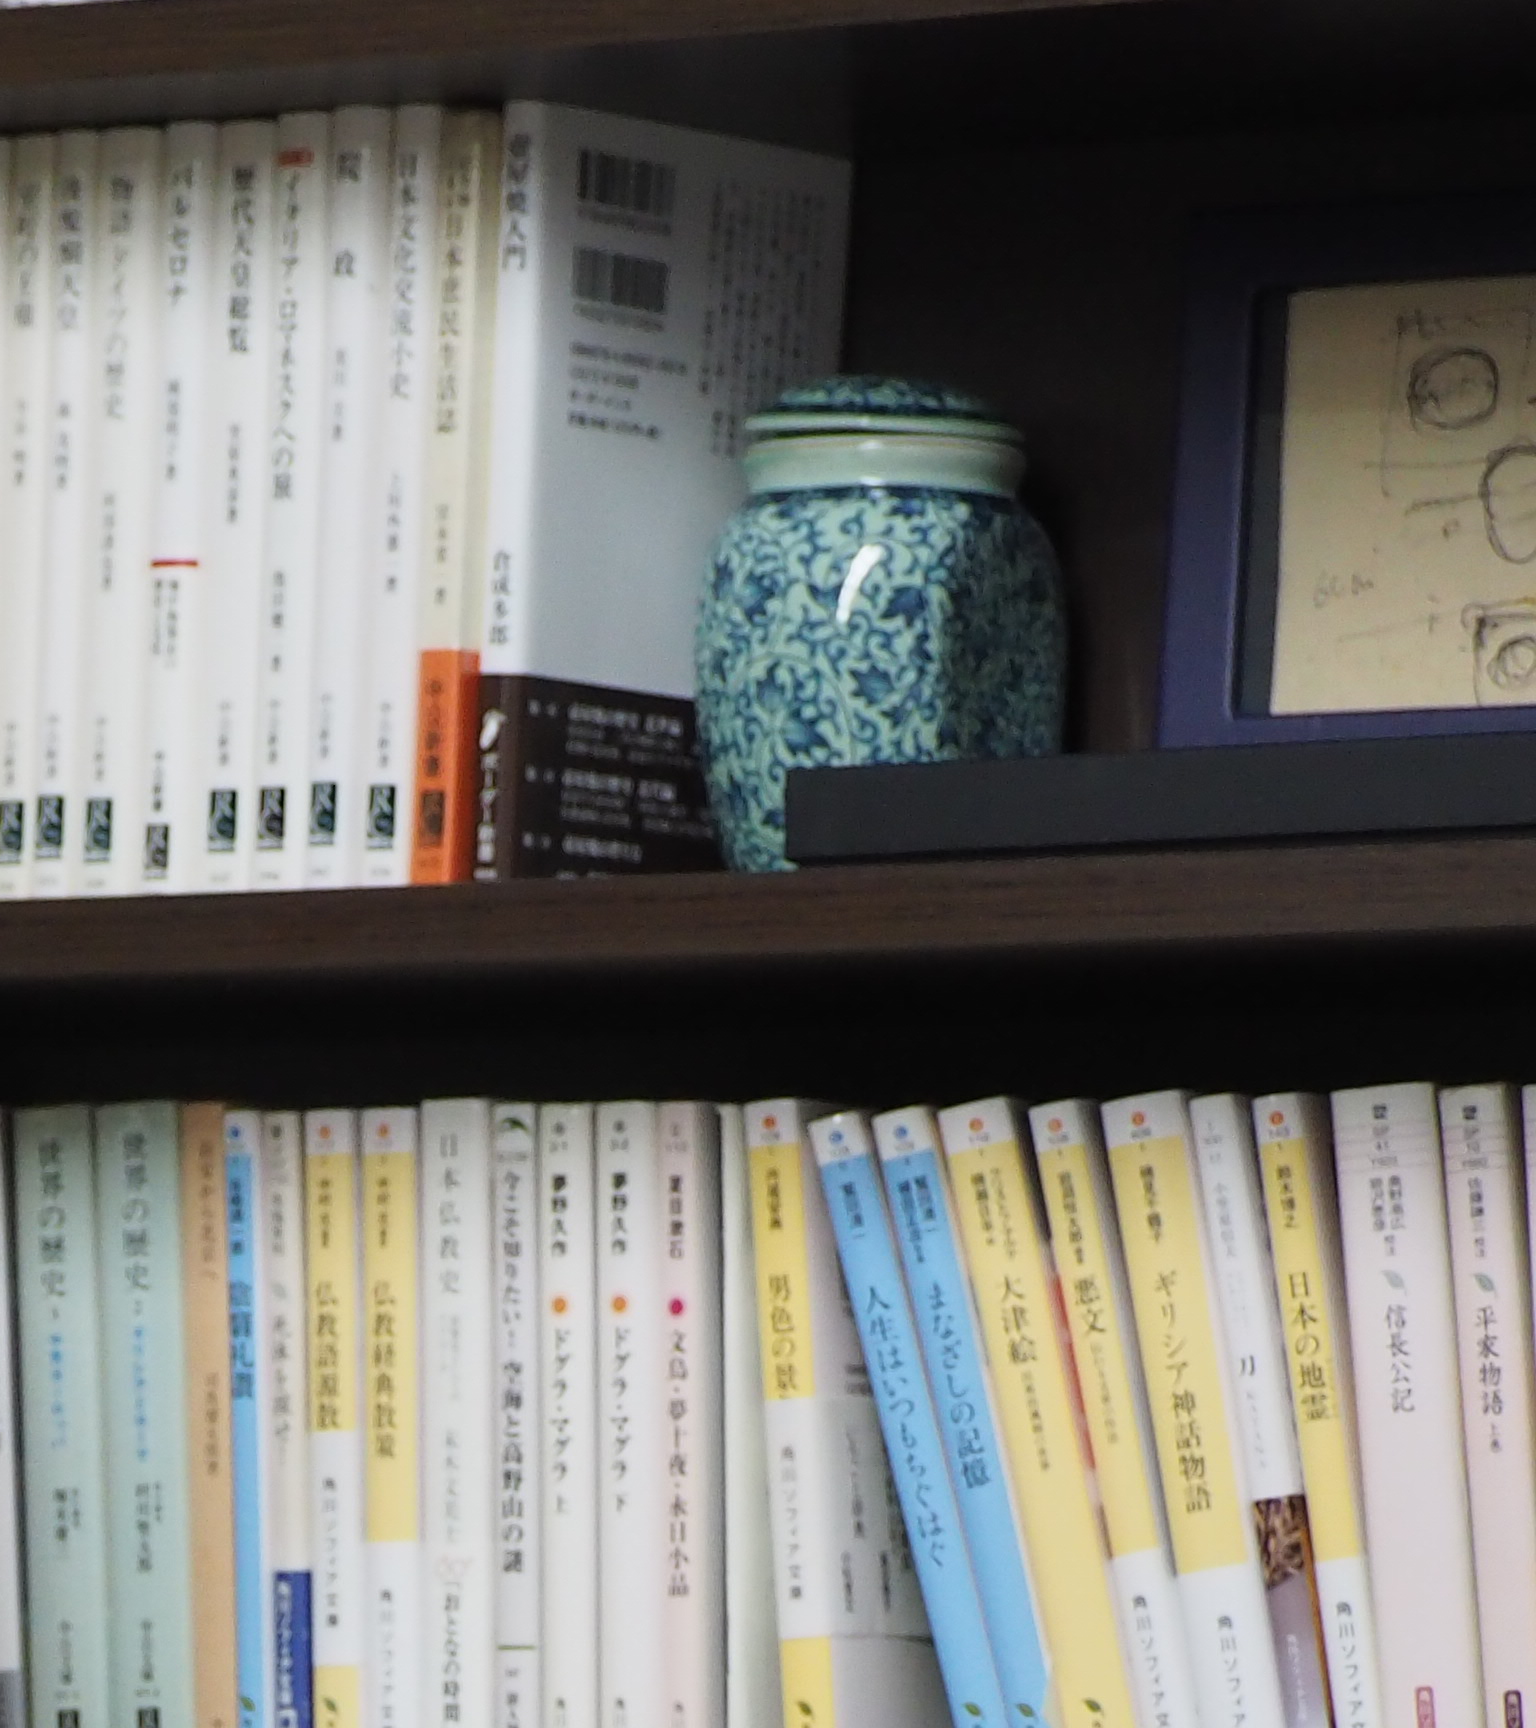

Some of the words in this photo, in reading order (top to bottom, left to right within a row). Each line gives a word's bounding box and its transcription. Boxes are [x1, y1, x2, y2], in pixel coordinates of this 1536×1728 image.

[438, 1132, 462, 1293] 日本仏教史
[551, 1173, 568, 1258] 夢野久作
[611, 1171, 628, 1257] 夢野久作
[668, 1173, 684, 1261] 夏目漱石
[1000, 1274, 1039, 1365] 大津絵
[1074, 1274, 1106, 1334] 悪文
[1287, 1270, 1331, 1424] 日本の地霊
[1382, 1303, 1416, 1416] 信長公記
[1473, 1305, 1505, 1417] 平家物語
[551, 1329, 570, 1482] ドグラ・マグラ
[611, 1328, 630, 1481] ドグラ・マグラ
[865, 1285, 945, 1569] 人生はいつもちぐはぐ
[928, 1280, 993, 1489] まなざしの記憶
[1153, 1268, 1214, 1515] ギリシア神話物語
[667, 1329, 689, 1597] 文鳥・夢十夜・永日小品
[781, 1445, 803, 1599] 角川ソフィア文庫
[323, 1476, 339, 1628] 角川ソフィア文庫
